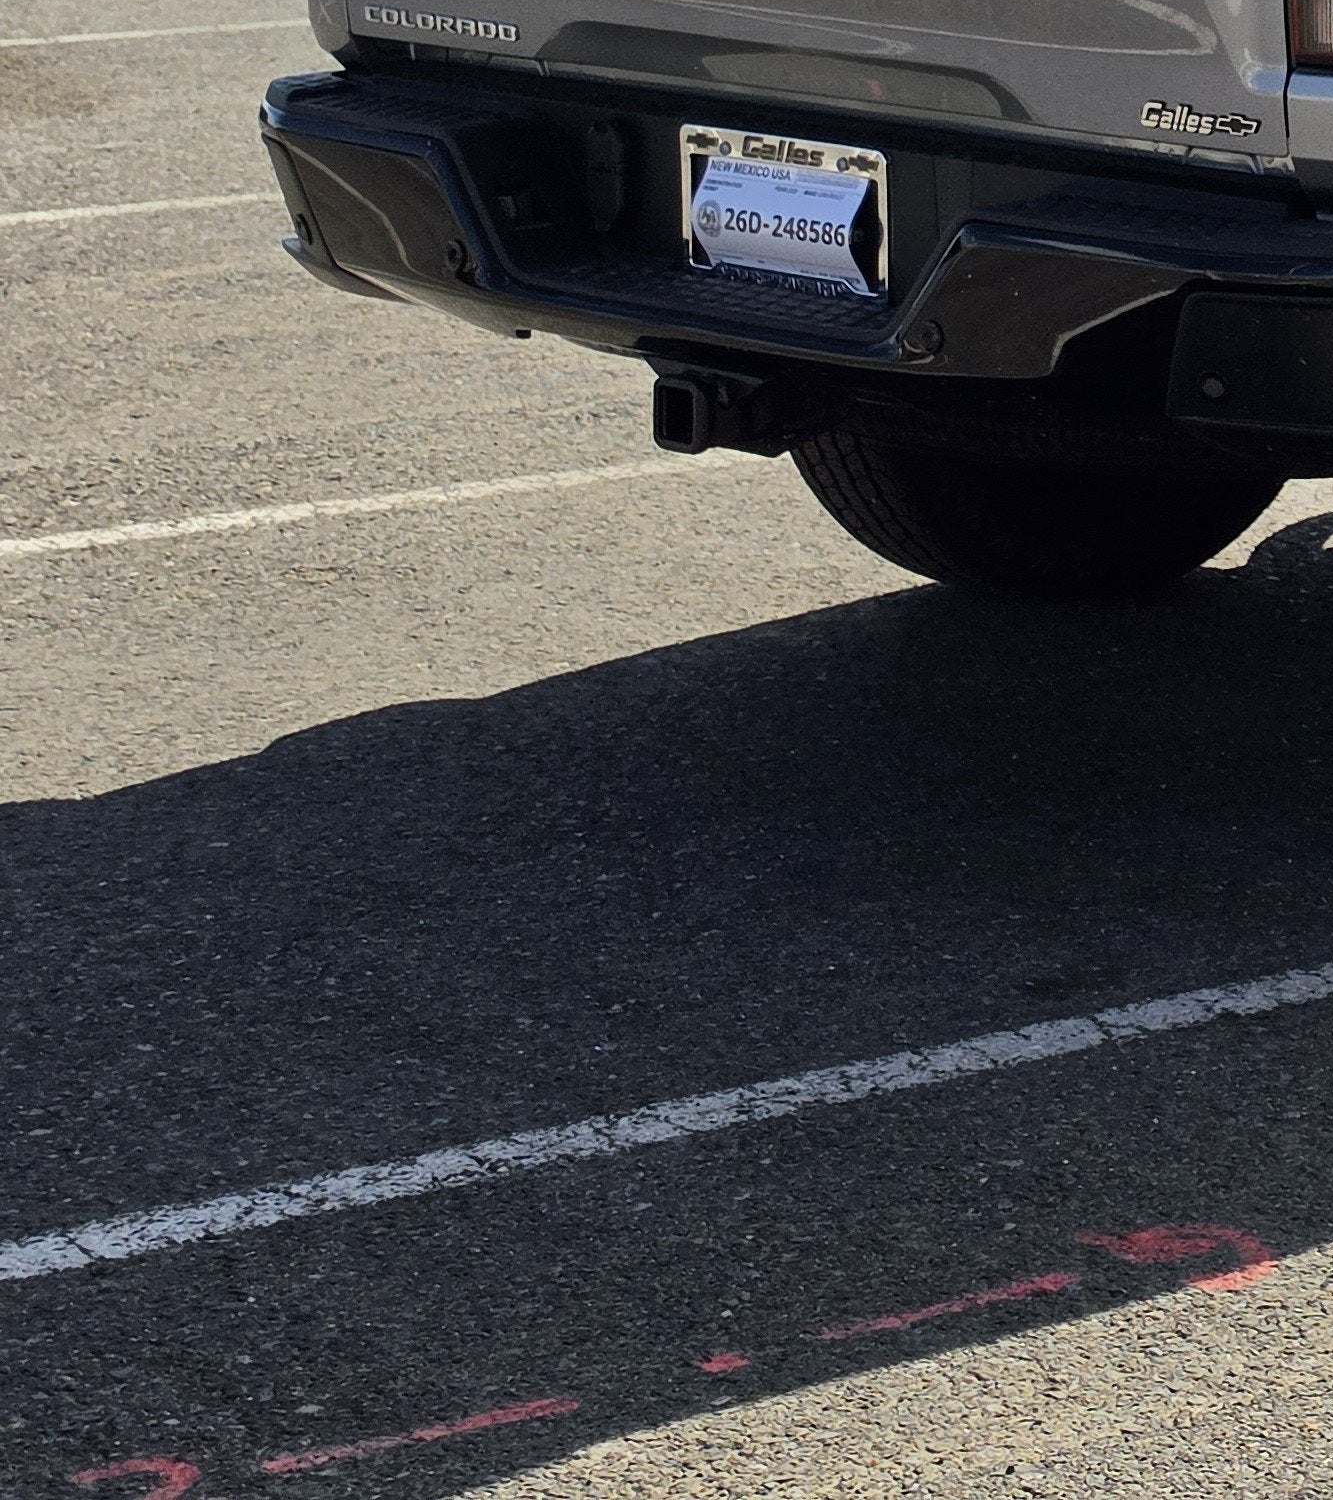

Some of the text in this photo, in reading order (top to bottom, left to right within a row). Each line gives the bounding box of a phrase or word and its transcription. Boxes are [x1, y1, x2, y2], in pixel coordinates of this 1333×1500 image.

[364, 4, 521, 43] COLORADO
[1140, 100, 1215, 135] Galles
[741, 135, 825, 168] Galles
[711, 160, 731, 173] NEW
[733, 162, 770, 179] MEXICO
[771, 168, 792, 181] USA
[724, 207, 847, 247] 26D-248586
